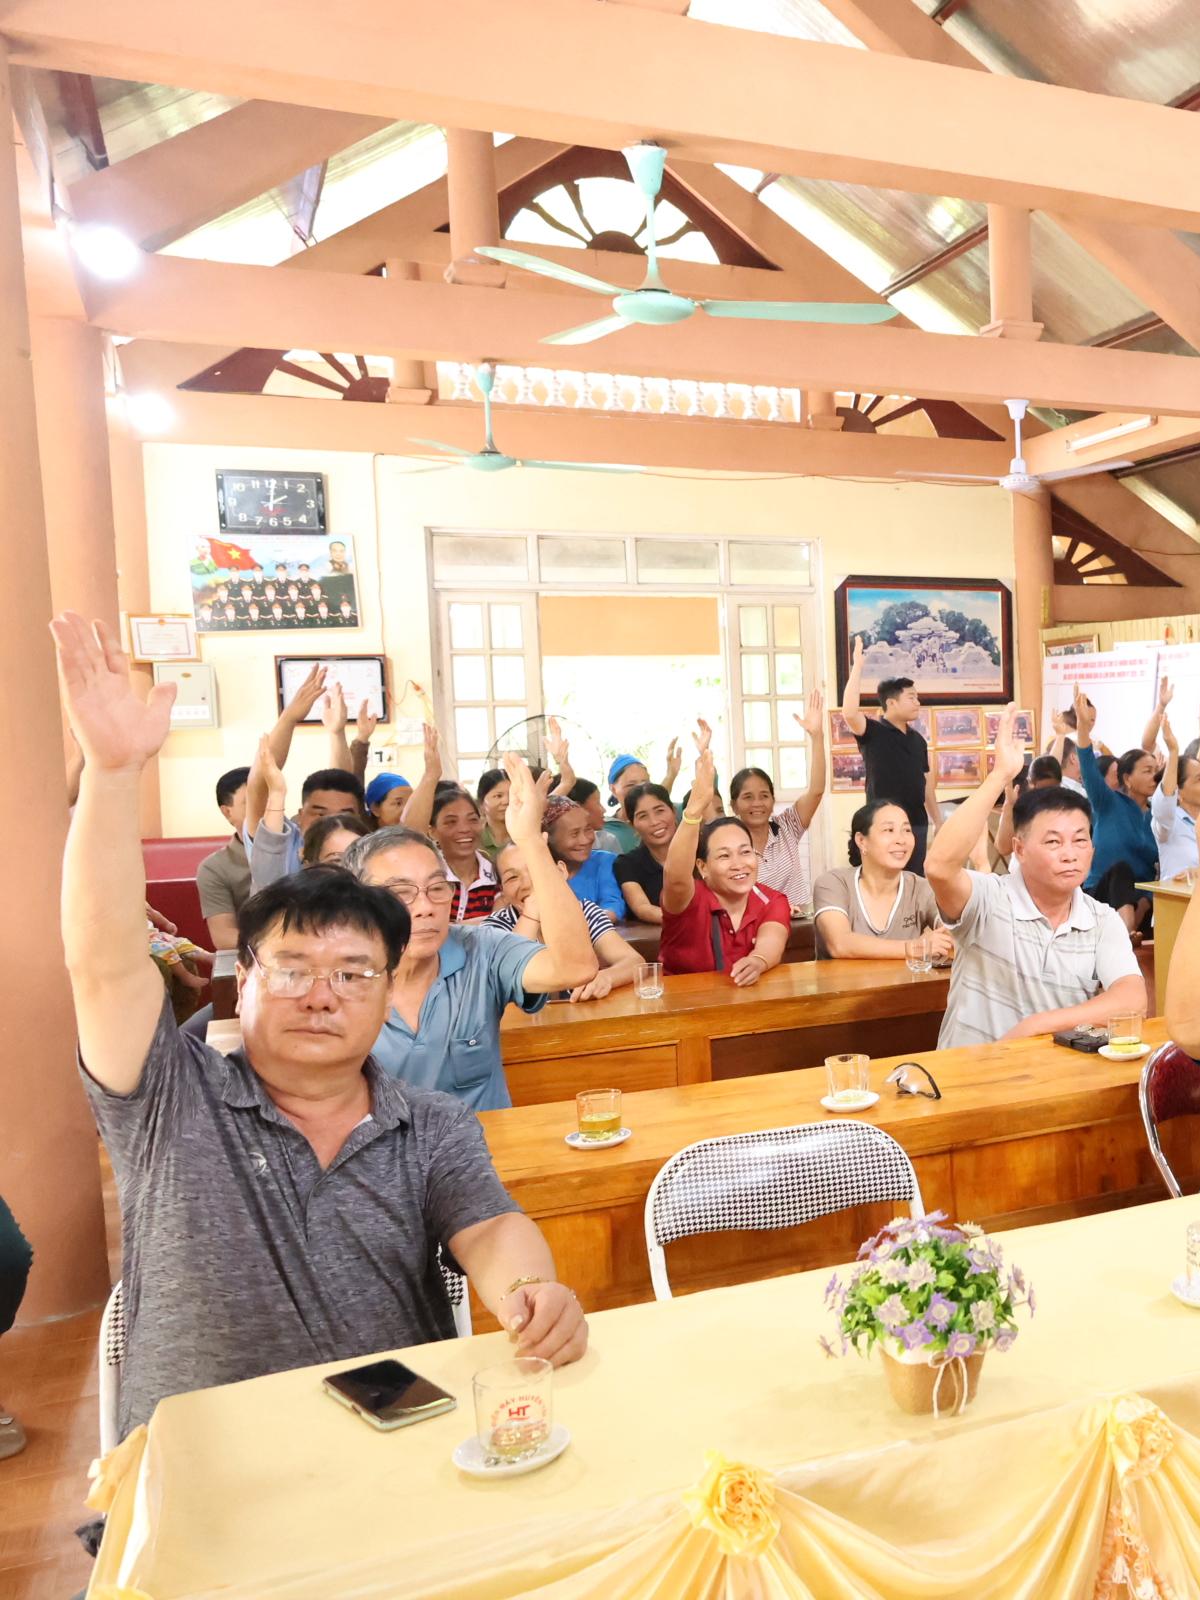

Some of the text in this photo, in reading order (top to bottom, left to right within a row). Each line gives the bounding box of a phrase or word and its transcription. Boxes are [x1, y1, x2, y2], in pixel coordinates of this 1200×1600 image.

[232, 483, 246, 492] 10
[251, 480, 260, 489] 11
[284, 481, 288, 490] 1
[296, 484, 306, 493] 2
[228, 497, 237, 507] 9
[306, 499, 315, 508] 3
[238, 513, 247, 522] 8
[255, 516, 263, 525] 7
[269, 518, 278, 526] 6
[283, 517, 292, 526] 5
[298, 514, 307, 523] 4
[508, 1404, 531, 1417] HT
